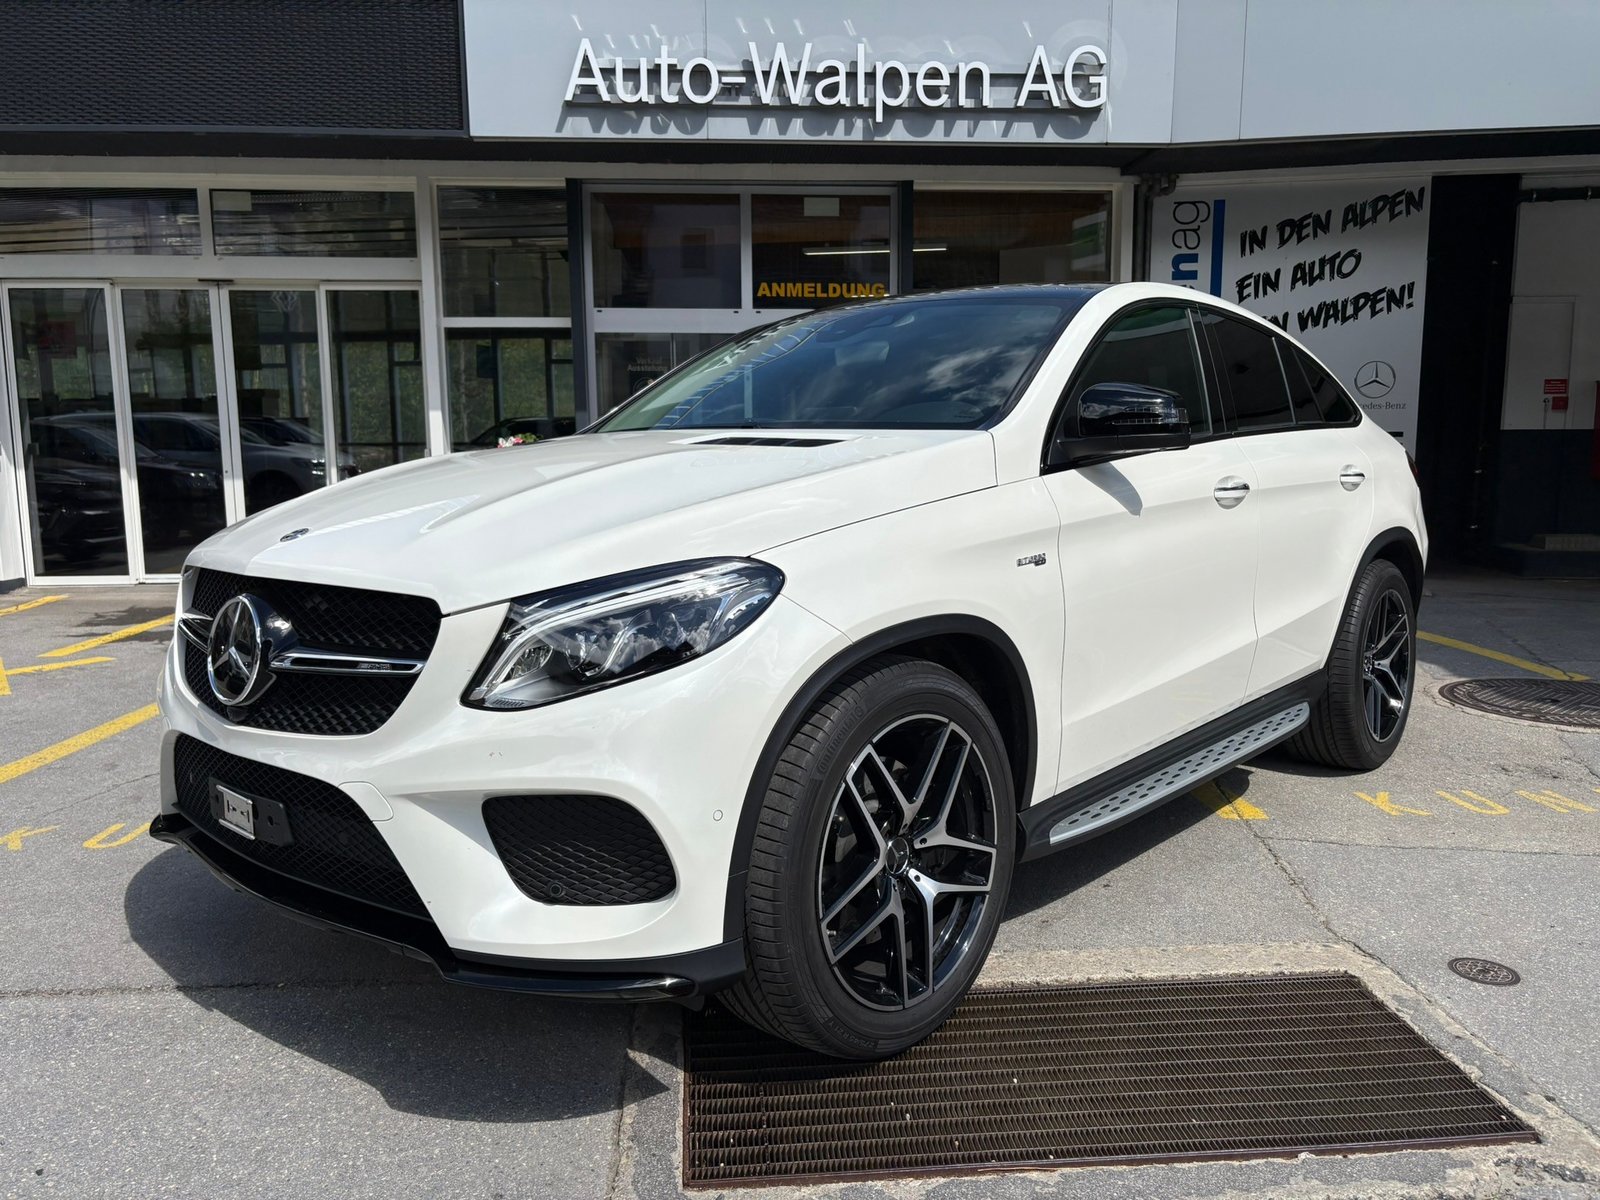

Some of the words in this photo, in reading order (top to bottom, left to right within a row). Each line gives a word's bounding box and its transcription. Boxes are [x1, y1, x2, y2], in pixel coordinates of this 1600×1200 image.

[565, 38, 991, 123] Auto-Walpen
[1016, 44, 1108, 109] AG
[1171, 201, 1211, 289] nag
[1240, 226, 1268, 258] IN
[1276, 209, 1332, 249] DEN
[1341, 186, 1425, 234] ALPEN
[757, 282, 885, 298] ANMELDUNG
[1236, 268, 1281, 304] EIN
[1290, 249, 1362, 292] AUTO
[1297, 281, 1415, 334] WALPEN!
[1353, 788, 1600, 816] KUN
